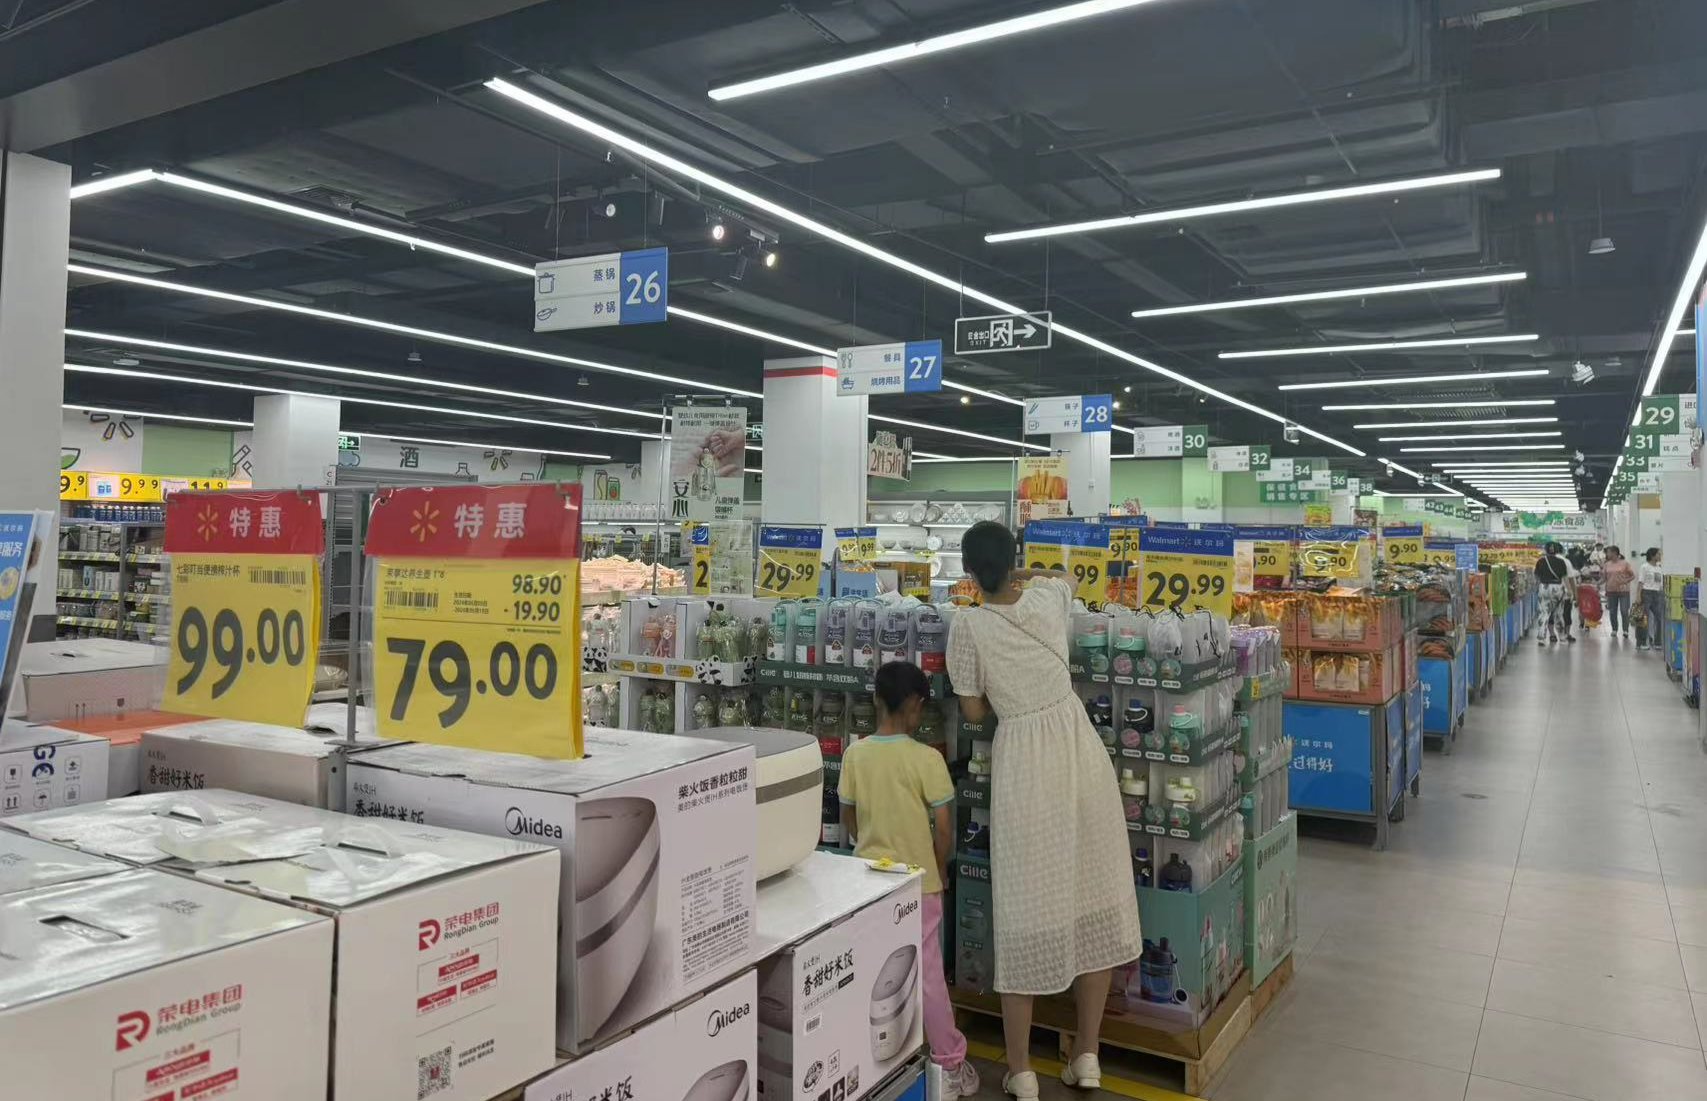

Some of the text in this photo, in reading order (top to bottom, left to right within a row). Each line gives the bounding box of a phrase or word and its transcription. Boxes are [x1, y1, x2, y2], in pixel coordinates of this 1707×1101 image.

[594, 267, 615, 281] 蒸锅
[625, 270, 661, 304] 26
[594, 301, 615, 314] 炒锅
[909, 355, 937, 380] 27
[1085, 405, 1108, 423] 28
[1645, 406, 1675, 425] 29
[1185, 433, 1205, 449] 30
[1635, 434, 1653, 449] 31
[399, 446, 420, 468] 酒
[1252, 452, 1267, 465] 32
[1295, 465, 1310, 476] 34
[1332, 476, 1345, 486] 36
[1619, 471, 1636, 482] 35
[1360, 482, 1374, 493] 38
[229, 505, 281, 539] 特惠
[454, 502, 528, 539] 特惠
[1032, 526, 1062, 538] Walmart
[1148, 535, 1181, 547] Walmart
[1111, 542, 1139, 558] 990
[1253, 554, 1277, 567] .90
[1389, 542, 1418, 559] 9.90
[512, 574, 561, 596] 98.90
[761, 561, 815, 592] 29.99
[1147, 571, 1226, 607] 29.99
[177, 606, 305, 700] 99.00
[386, 637, 558, 729] 79.00
[962, 721, 984, 732] Cille
[149, 765, 206, 790] 香甜好米饭
[678, 766, 748, 801] 柴火饭香粒粒甜
[962, 789, 984, 800] Cille
[355, 799, 425, 824] 香甜好米饭
[505, 806, 563, 839] Midea
[960, 865, 989, 881] Cille
[444, 901, 500, 932] 荣电集团
[893, 900, 918, 925] Midea
[444, 914, 499, 942] RongDian Group
[803, 948, 854, 997] 香甜好米饭
[157, 983, 243, 1022] 荣电集团
[156, 1002, 242, 1036] RongDian Group
[707, 1002, 751, 1038] Midea
